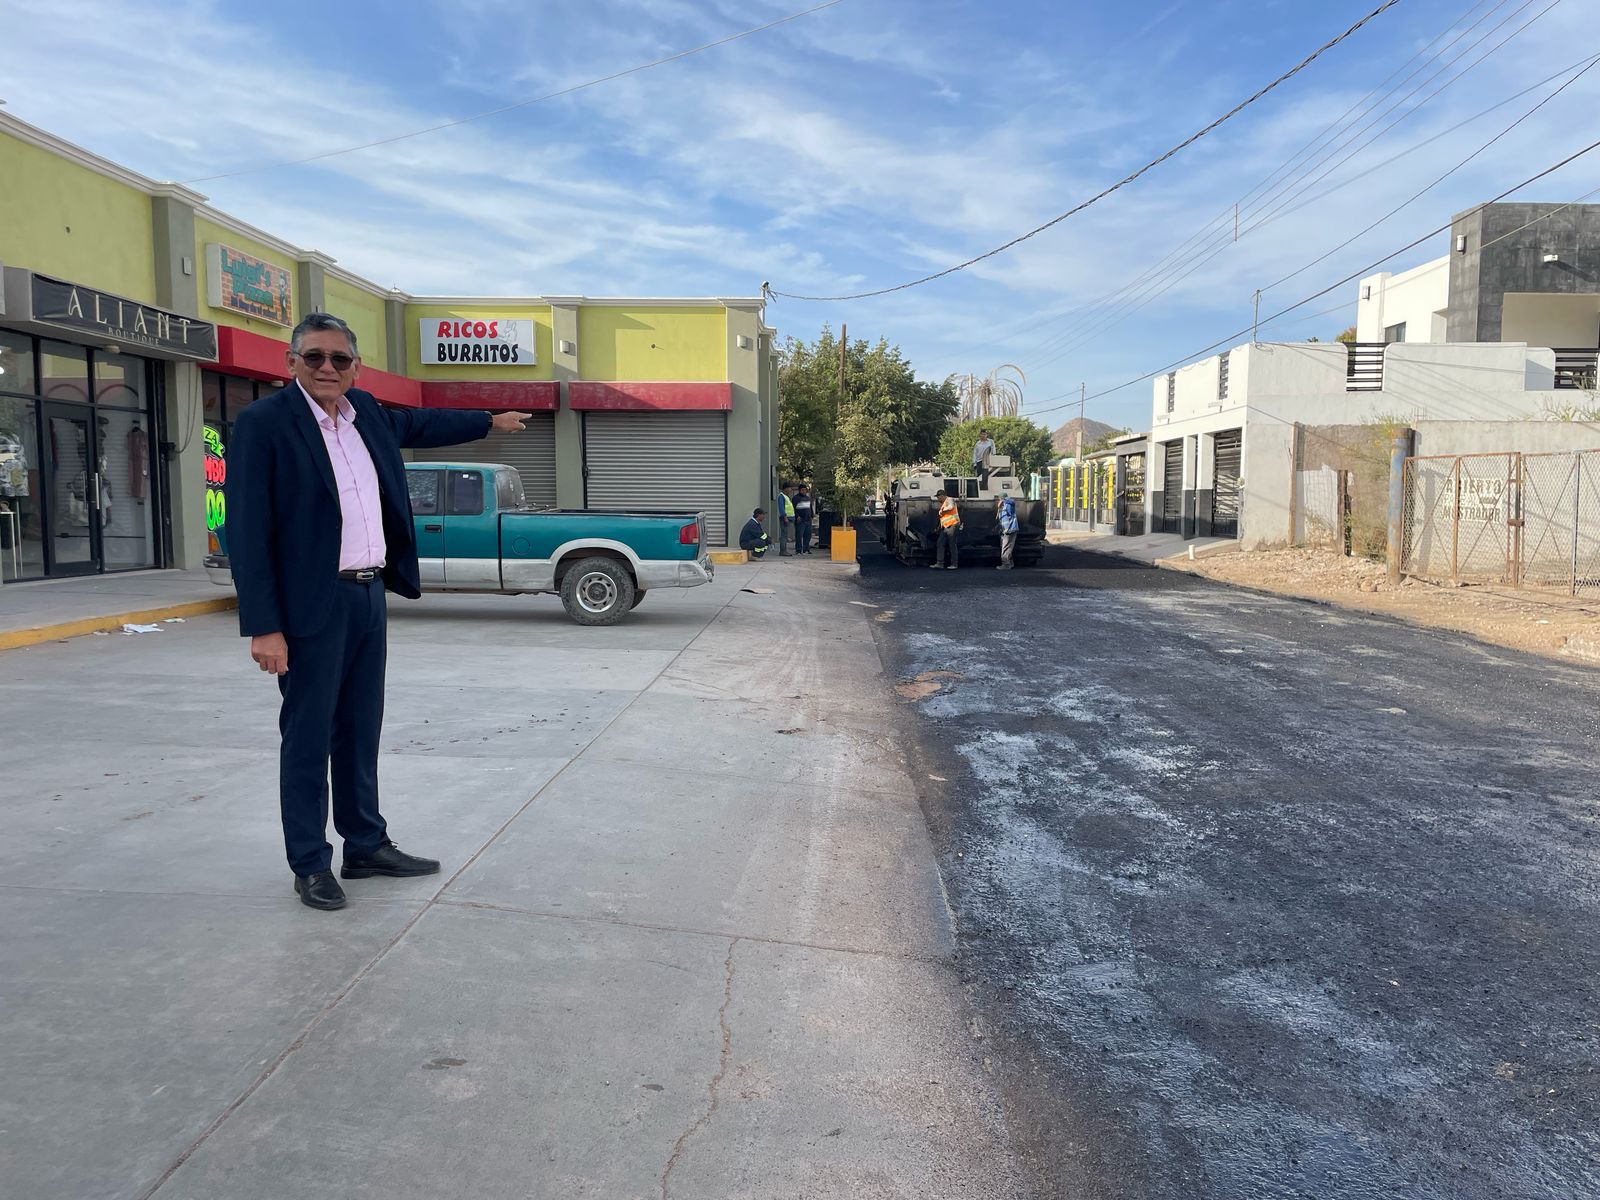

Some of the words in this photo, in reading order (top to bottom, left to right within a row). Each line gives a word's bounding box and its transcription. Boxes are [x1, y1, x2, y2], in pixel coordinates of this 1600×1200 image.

[68, 286, 191, 344] ALIANT
[108, 327, 160, 345] BOUTIQUE
[437, 321, 498, 339] RICOS
[437, 343, 519, 363] BURRITOS
[204, 429, 218, 445] ZA
[204, 455, 226, 483] MBO
[1445, 479, 1501, 495] AIERTO
[206, 489, 226, 530] 00
